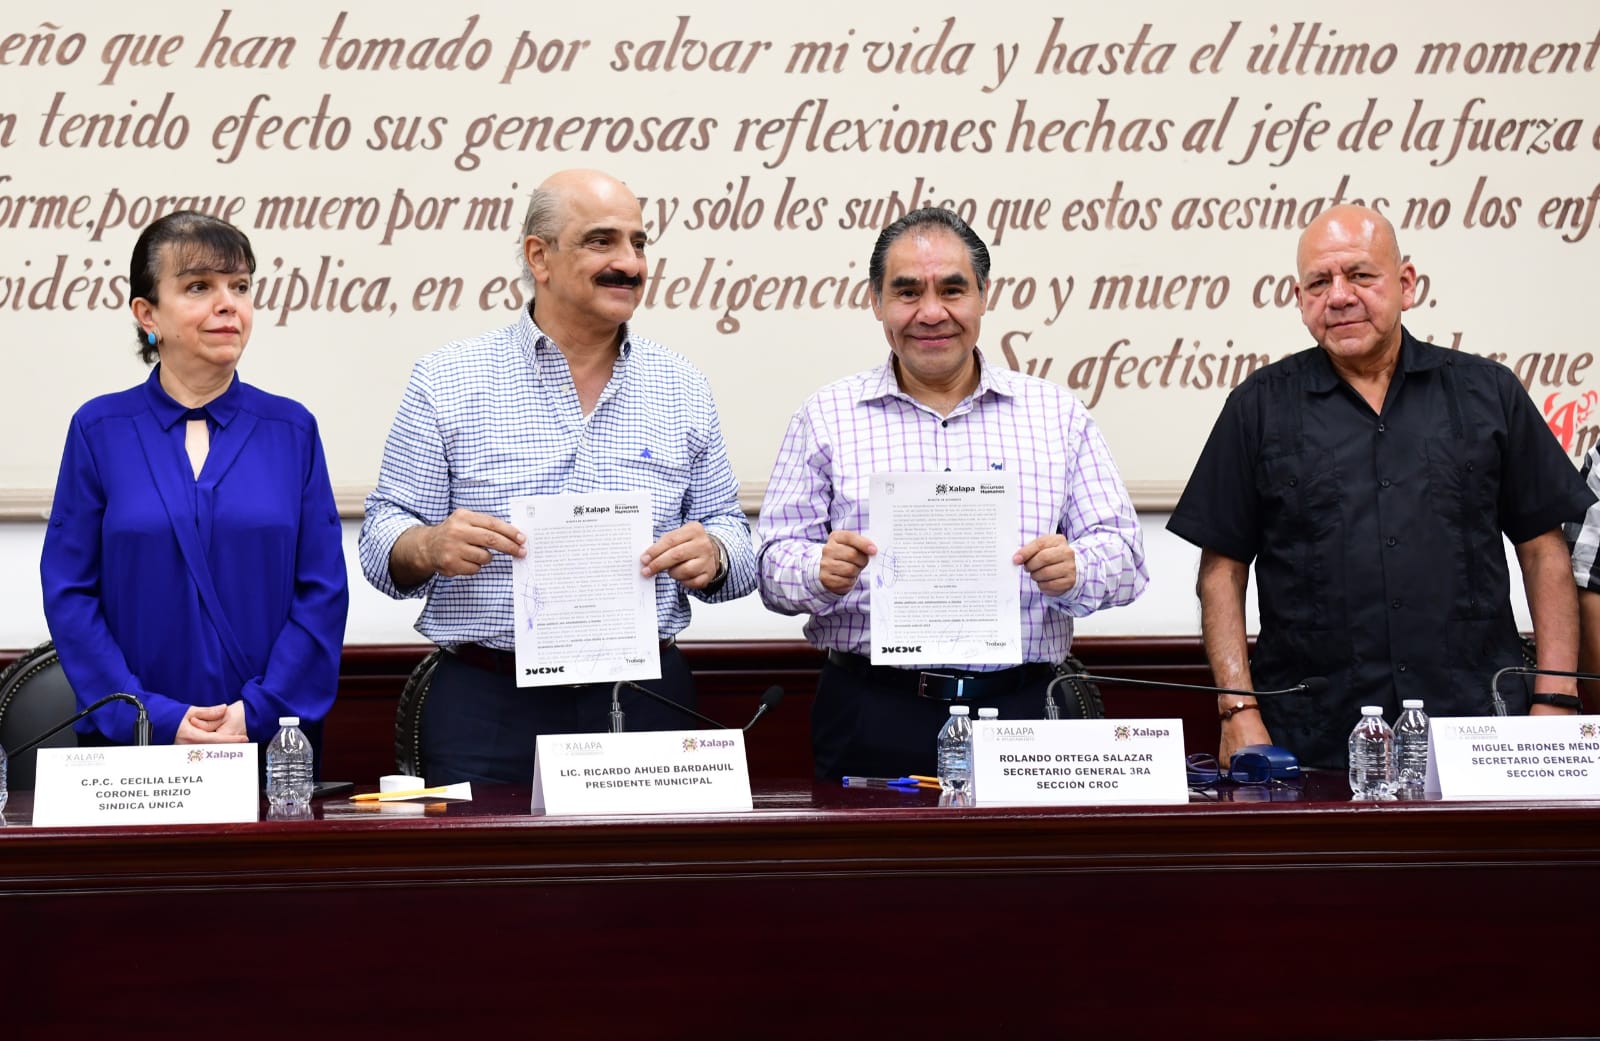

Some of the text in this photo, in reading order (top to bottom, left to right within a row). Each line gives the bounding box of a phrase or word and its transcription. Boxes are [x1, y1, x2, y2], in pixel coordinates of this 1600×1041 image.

[98, 33, 185, 86] que
[195, 9, 297, 69] han
[318, 11, 493, 71] tomado
[500, 30, 591, 84] por
[609, 15, 772, 73] salvar
[785, 28, 856, 73] mi
[863, 17, 976, 75] vida
[981, 41, 1019, 93] y
[1034, 17, 1177, 75] hasta
[1188, 21, 1242, 74] el
[1246, 22, 1398, 75] último
[1415, 28, 1600, 75] moment
[38, 92, 190, 150] tenido
[211, 93, 352, 164] efecto
[366, 115, 448, 152] sus
[454, 114, 718, 171] generosas
[733, 98, 996, 169] reflexiones
[1006, 99, 1175, 153] hechas
[1182, 97, 1240, 154] al
[1228, 101, 1330, 167] jefe
[1337, 98, 1393, 153] de
[1400, 99, 1445, 153] la
[1430, 97, 1584, 167] fuerza
[254, 195, 380, 231] muero
[380, 188, 460, 245] por
[463, 182, 519, 231] mi
[684, 175, 765, 232] sólo
[774, 176, 828, 231] les
[987, 197, 1052, 246] que
[1062, 180, 1162, 232] estos
[1400, 197, 1451, 230] no
[1463, 175, 1523, 230] los
[252, 255, 398, 327] úplica,
[411, 276, 465, 312] en
[478, 276, 526, 312] es
[644, 257, 872, 335] teligencia
[1044, 275, 1075, 327] y
[1089, 273, 1231, 311] muero
[948, 485, 976, 493] Xalapa
[585, 506, 610, 515] Xalapa
[995, 727, 1035, 736] XALAPA
[1132, 727, 1170, 738] Xalapa
[1458, 725, 1497, 734] XALAPA
[564, 741, 603, 750] XALAPA
[699, 738, 735, 749] Xalapa
[1472, 743, 1514, 752] MIGUEL
[1517, 742, 1565, 751] BRIONES
[65, 752, 106, 762] XALAPA
[205, 749, 244, 760] Xalapa
[999, 753, 1153, 763] ROLANDO ORTEGA SALAZAR
[1472, 756, 1540, 765] SECRETARIO
[1543, 755, 1595, 764] GENERAL
[560, 763, 735, 777] LIC. RICARDO AHUED BARDAHUIL
[1003, 766, 1151, 777] SECRETARIO GENERAL 3RA
[1558, 769, 1589, 777] CROC
[80, 775, 203, 787] C.P.C. CECILIA LEYLA
[585, 776, 713, 789] PRESIDENTE MUNICIPAL
[1088, 780, 1119, 789] CROC
[95, 788, 192, 799] CORONEL BRIZIO
